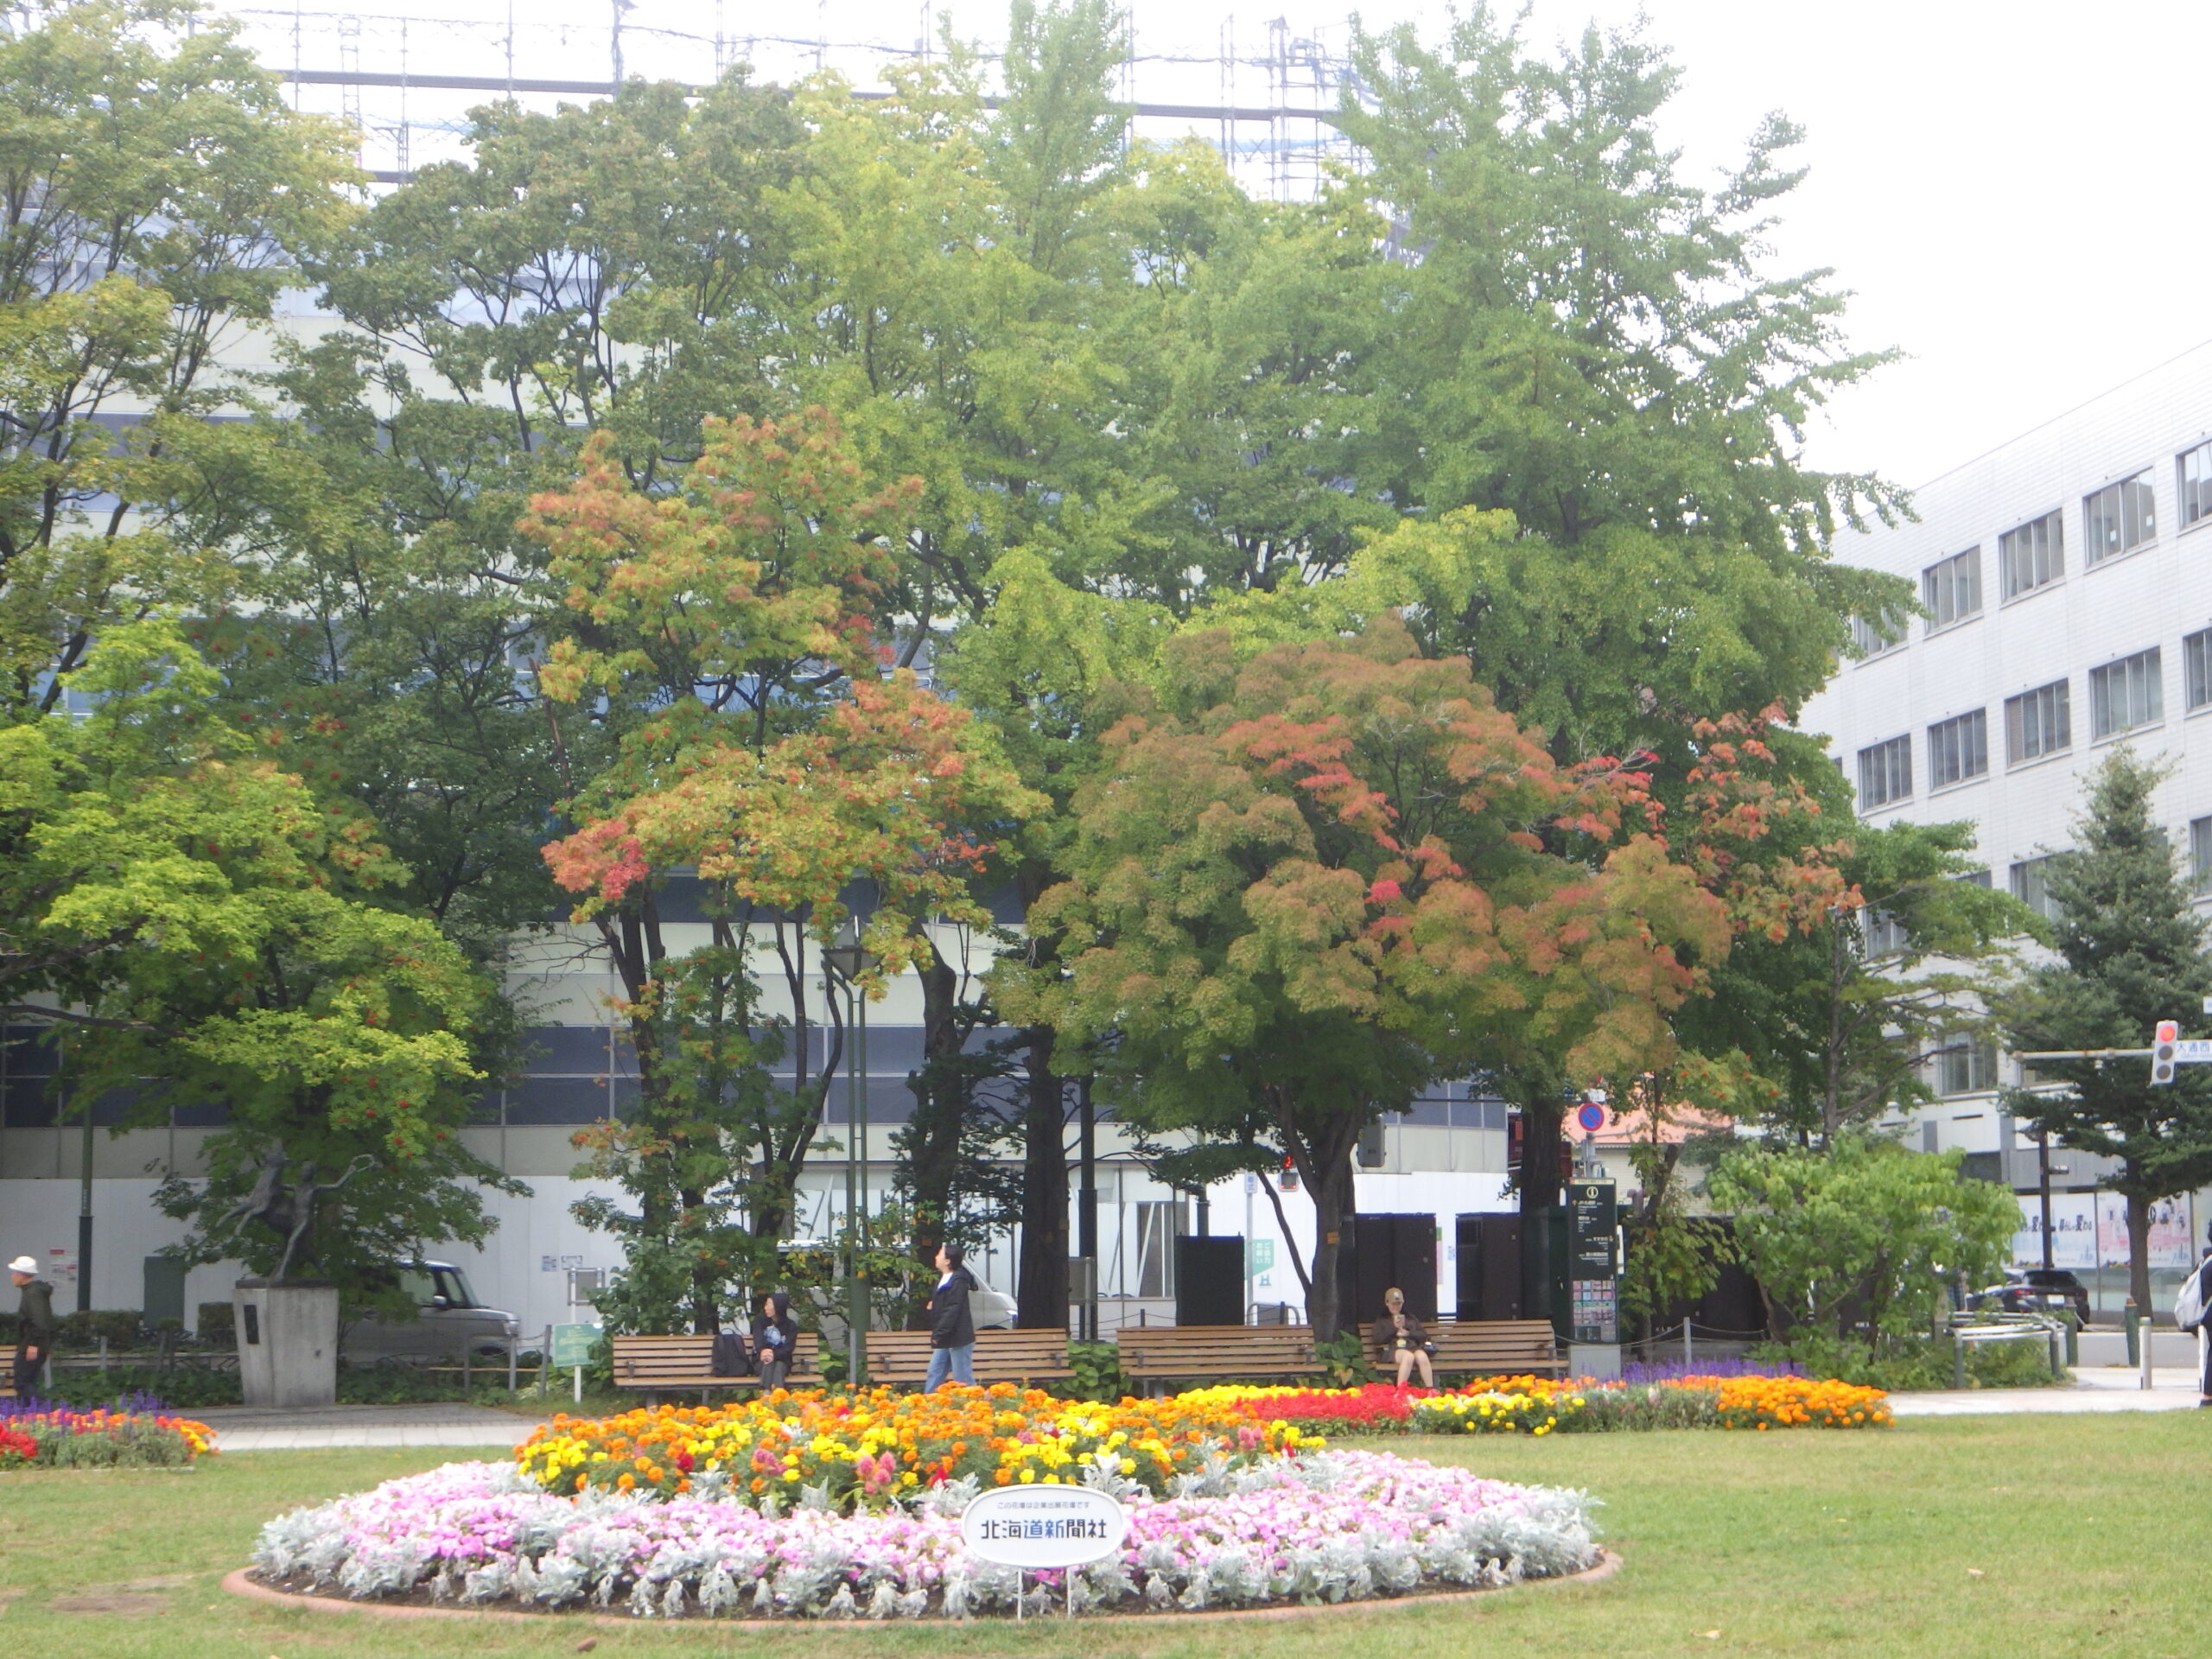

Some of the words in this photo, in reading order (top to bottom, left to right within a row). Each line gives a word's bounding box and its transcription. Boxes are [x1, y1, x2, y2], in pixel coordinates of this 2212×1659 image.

[981, 1519, 1107, 1539] 北海道新聞社
